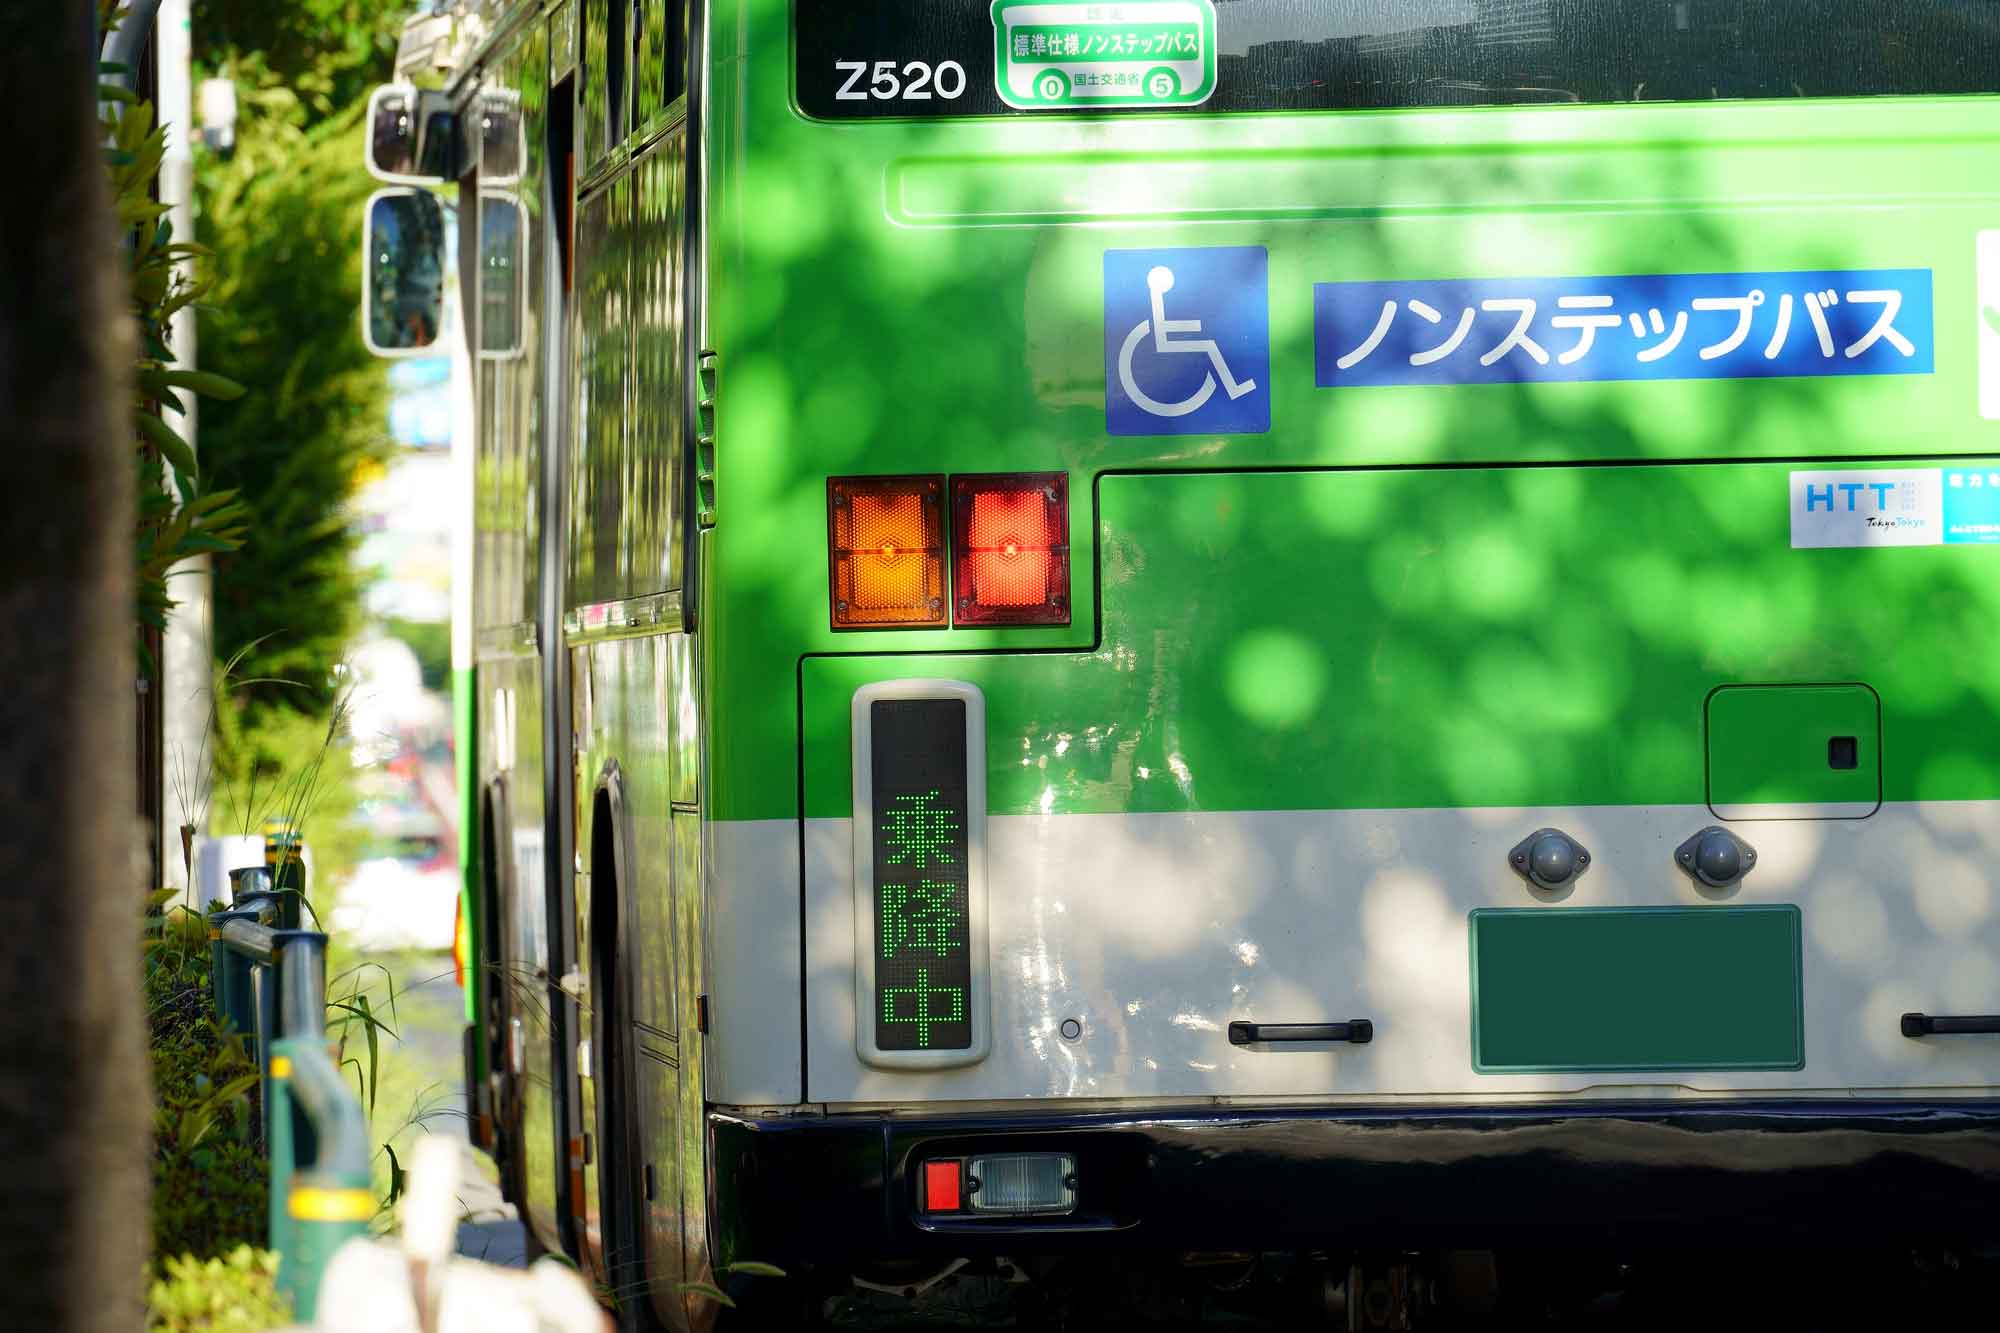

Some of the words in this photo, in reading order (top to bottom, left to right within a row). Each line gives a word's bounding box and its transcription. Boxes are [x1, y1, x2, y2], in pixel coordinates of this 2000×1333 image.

[1014, 32, 1198, 57] 標準仕様ノンステップバス
[835, 61, 966, 100] Z520
[1074, 72, 1140, 86] 国土交通省
[1156, 77, 1168, 95] 5
[1336, 288, 1916, 370] ノンステップバス
[1807, 483, 1895, 512] HTT
[881, 791, 962, 1047] 乗降中
